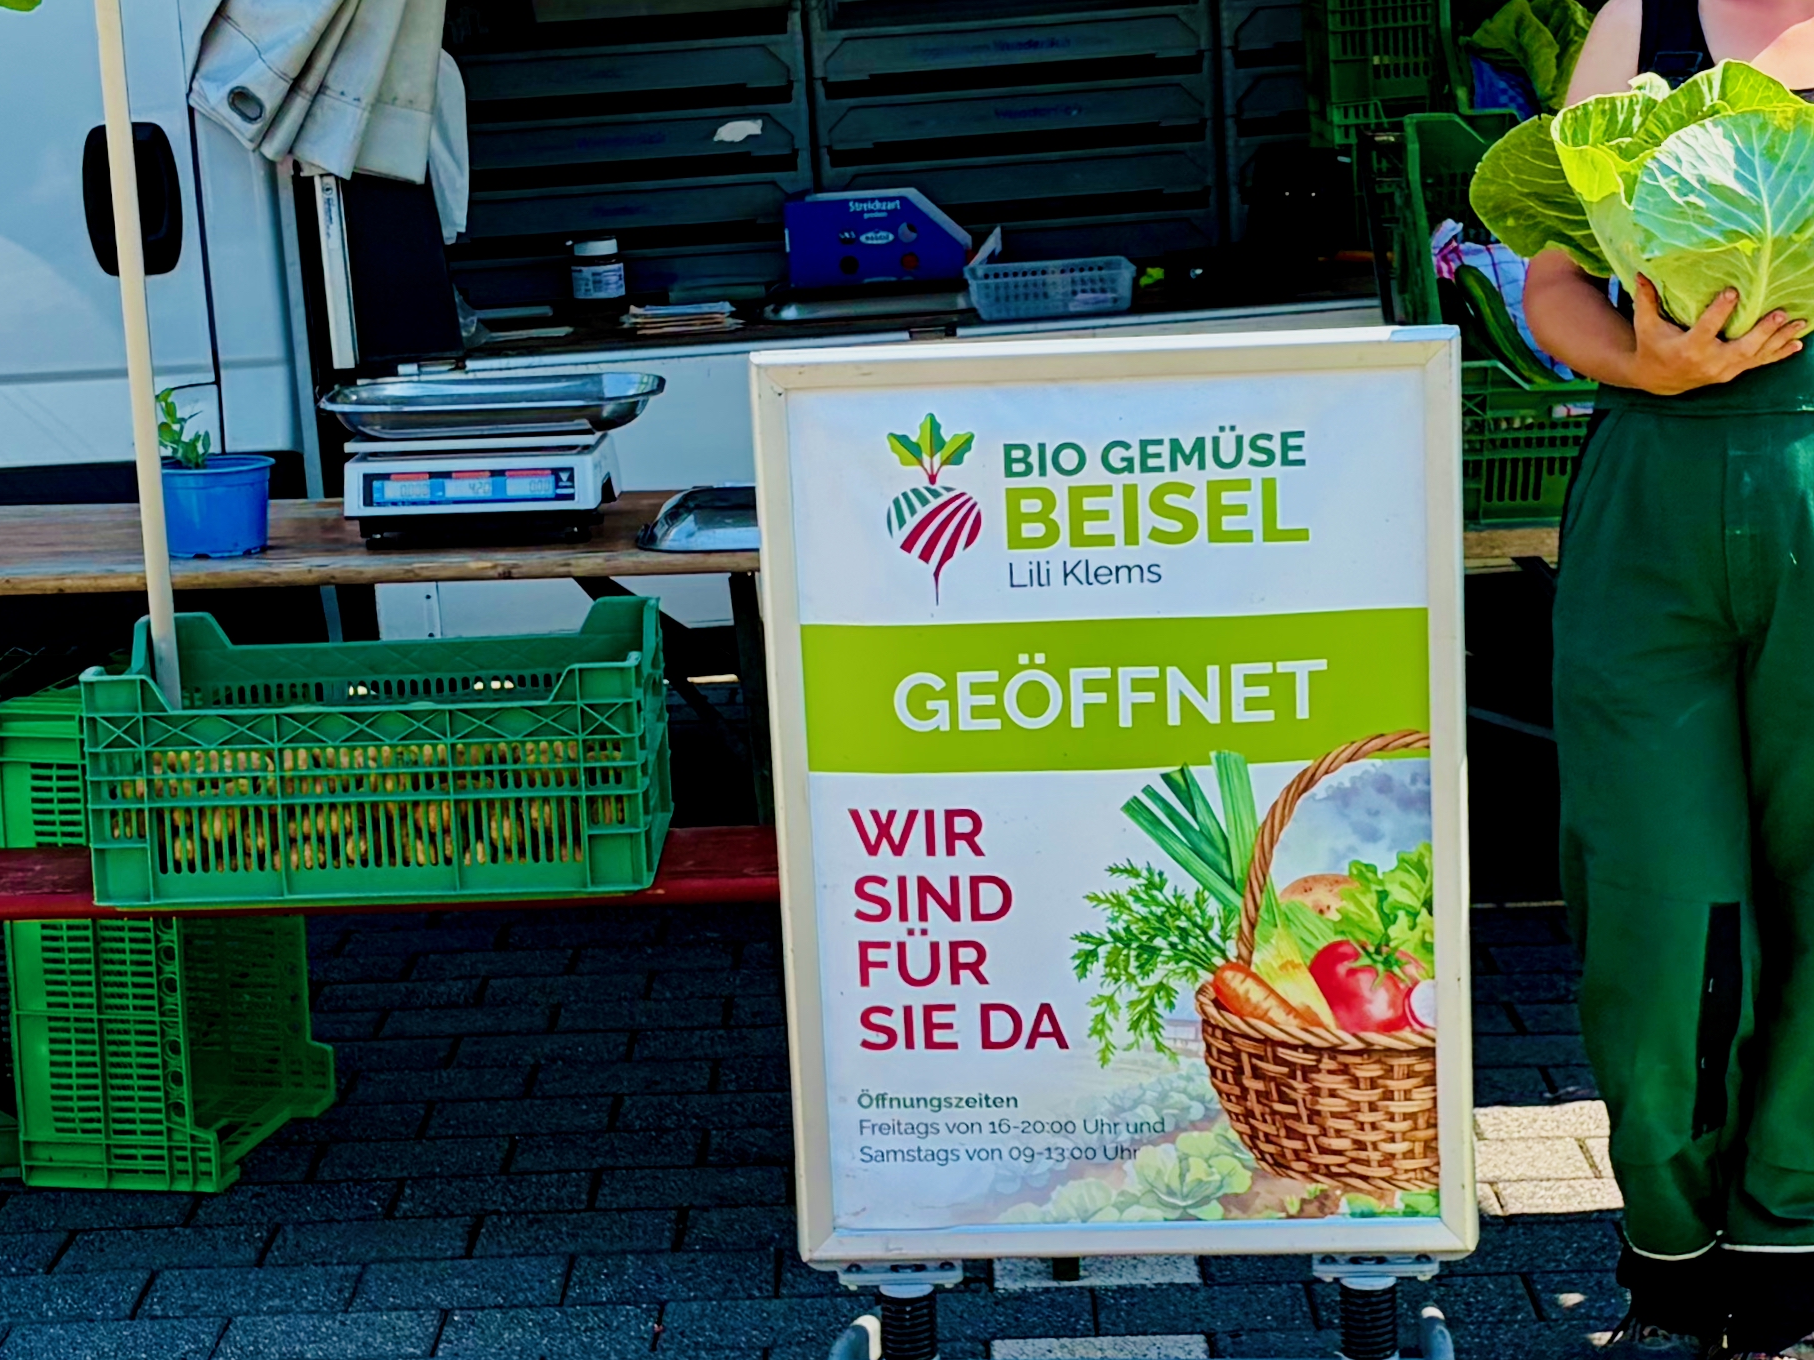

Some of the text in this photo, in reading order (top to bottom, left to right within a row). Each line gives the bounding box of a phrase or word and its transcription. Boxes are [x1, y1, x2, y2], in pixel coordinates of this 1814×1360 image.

[1003, 426, 1306, 479] BIO GEMÜSE
[1005, 477, 1310, 550] BEISEL
[1008, 559, 1162, 589] Lili Klems
[893, 653, 1328, 732] GEÖFFNET
[848, 808, 985, 857] WIR
[854, 874, 1013, 923] SIND
[859, 927, 989, 987] FÜR
[860, 1001, 1069, 1051] SIE DA
[857, 1089, 1018, 1113] Öffnungszeiten
[859, 1117, 1166, 1139] Freitags von 16-20:00 Uhr und
[859, 1145, 1139, 1166] Samstags von 09-13:00 Uhr
